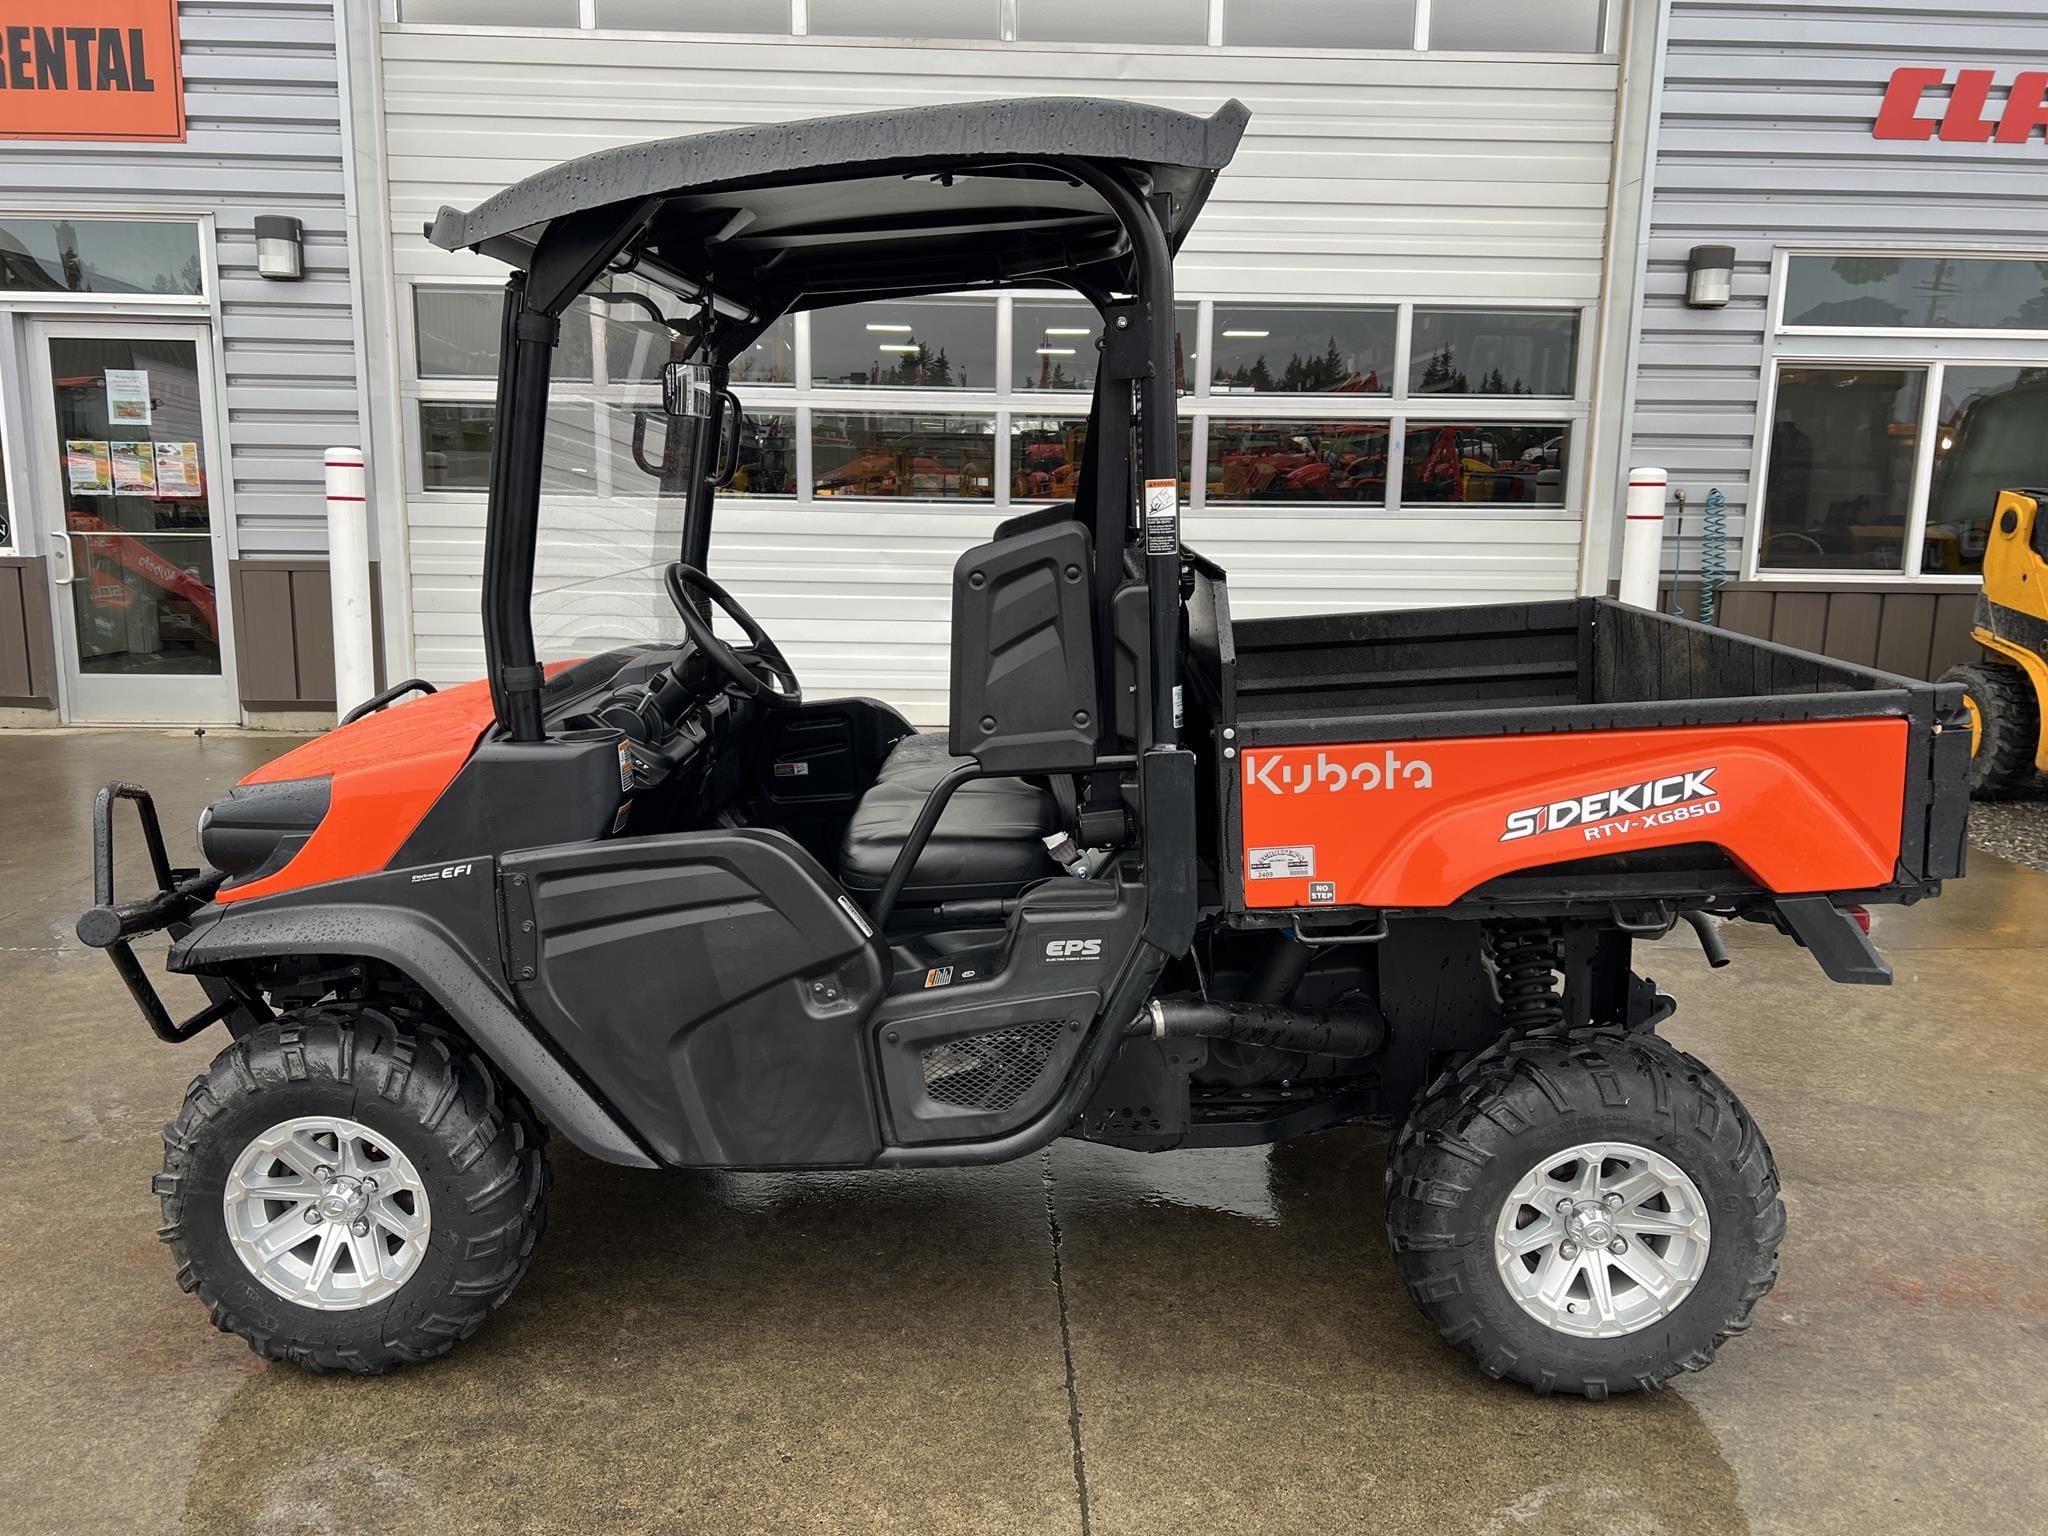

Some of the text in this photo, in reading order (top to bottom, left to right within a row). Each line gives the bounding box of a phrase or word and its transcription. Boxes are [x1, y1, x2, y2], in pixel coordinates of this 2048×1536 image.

[0, 26, 155, 92] ENTAL
[1246, 750, 1432, 795] Kubota
[1498, 767, 1718, 842] SIDEKICK
[1583, 799, 1722, 842] RTV-XG850
[441, 863, 472, 879] EFI
[1311, 892, 1333, 900] STEP
[1046, 939, 1102, 956] EPS
